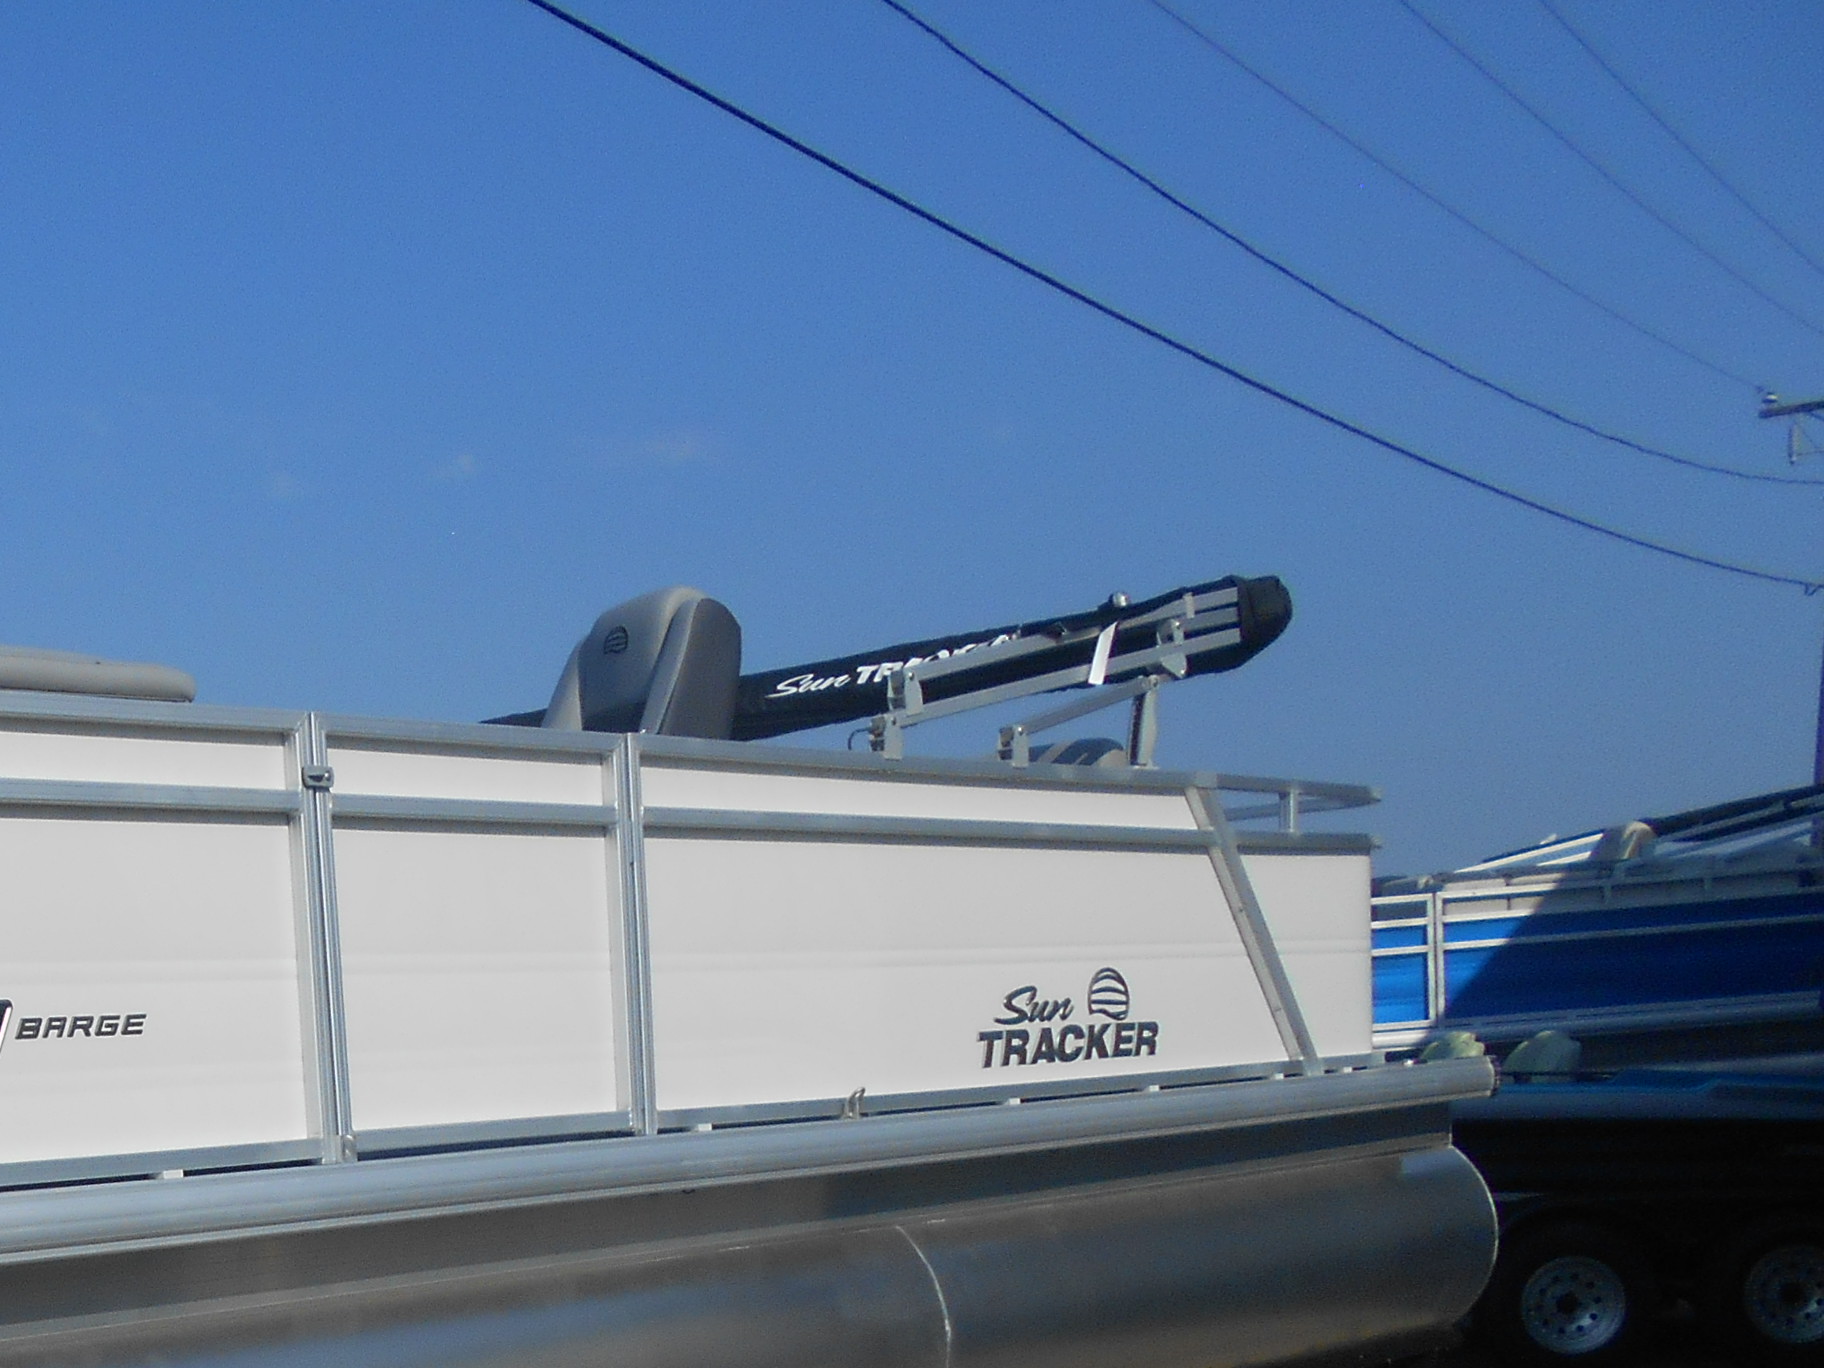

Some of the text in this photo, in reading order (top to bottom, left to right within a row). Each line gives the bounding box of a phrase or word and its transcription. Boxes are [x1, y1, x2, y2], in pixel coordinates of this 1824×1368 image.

[764, 672, 851, 699] Sun
[993, 985, 1074, 1026] Sun
[14, 1013, 147, 1040] BARGE
[978, 1020, 1159, 1069] TRACKER
